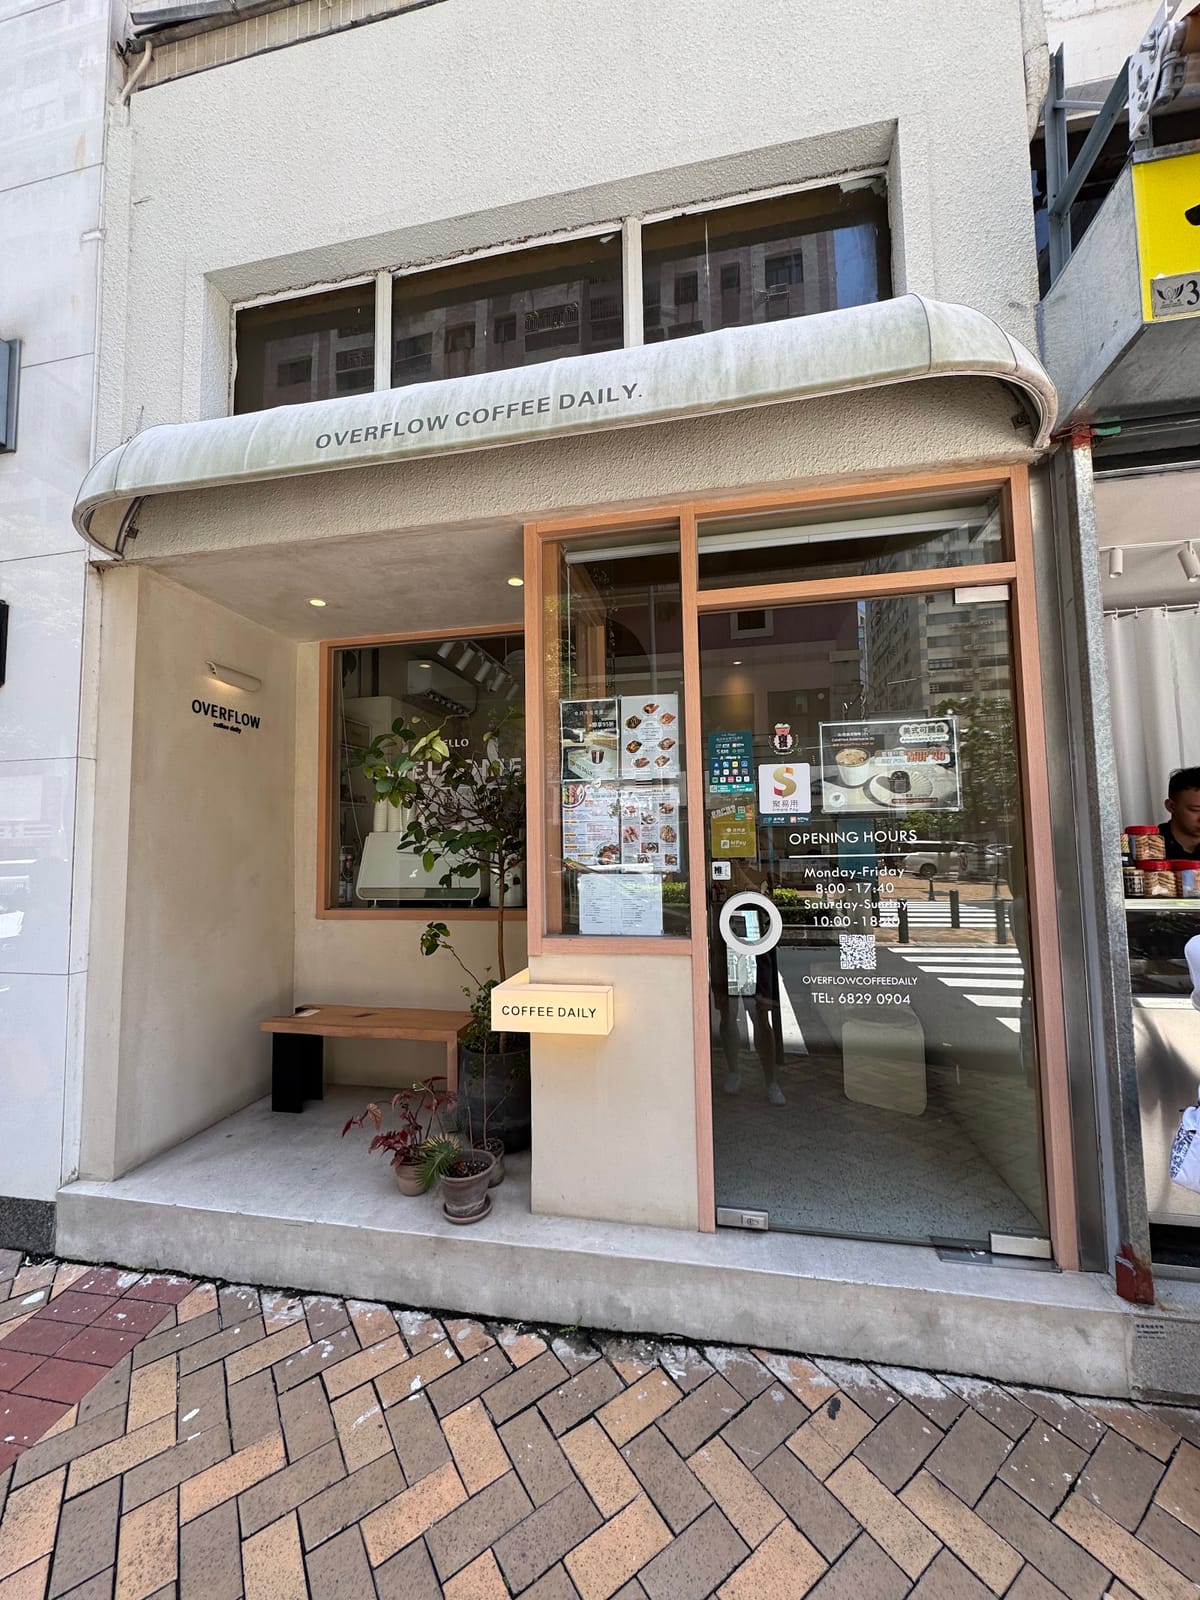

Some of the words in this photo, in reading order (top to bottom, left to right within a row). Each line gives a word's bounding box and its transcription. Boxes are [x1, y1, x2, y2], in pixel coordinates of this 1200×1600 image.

[315, 414, 449, 450] OVERFLOW
[455, 396, 551, 427] COFFEE
[558, 383, 643, 410] DAILY.
[191, 699, 261, 729] OVERFLOW
[789, 831, 859, 845] OPENING
[863, 830, 918, 843] HOURS
[804, 866, 905, 879] Monday-Friday
[802, 976, 918, 986] OVERFLOWCOFFEEDAILY
[811, 992, 834, 1003] TEL:
[838, 993, 872, 1004] 6829
[876, 993, 911, 1005] 0904
[501, 1005, 555, 1017] COFFEE
[558, 1007, 597, 1018] DAILY
